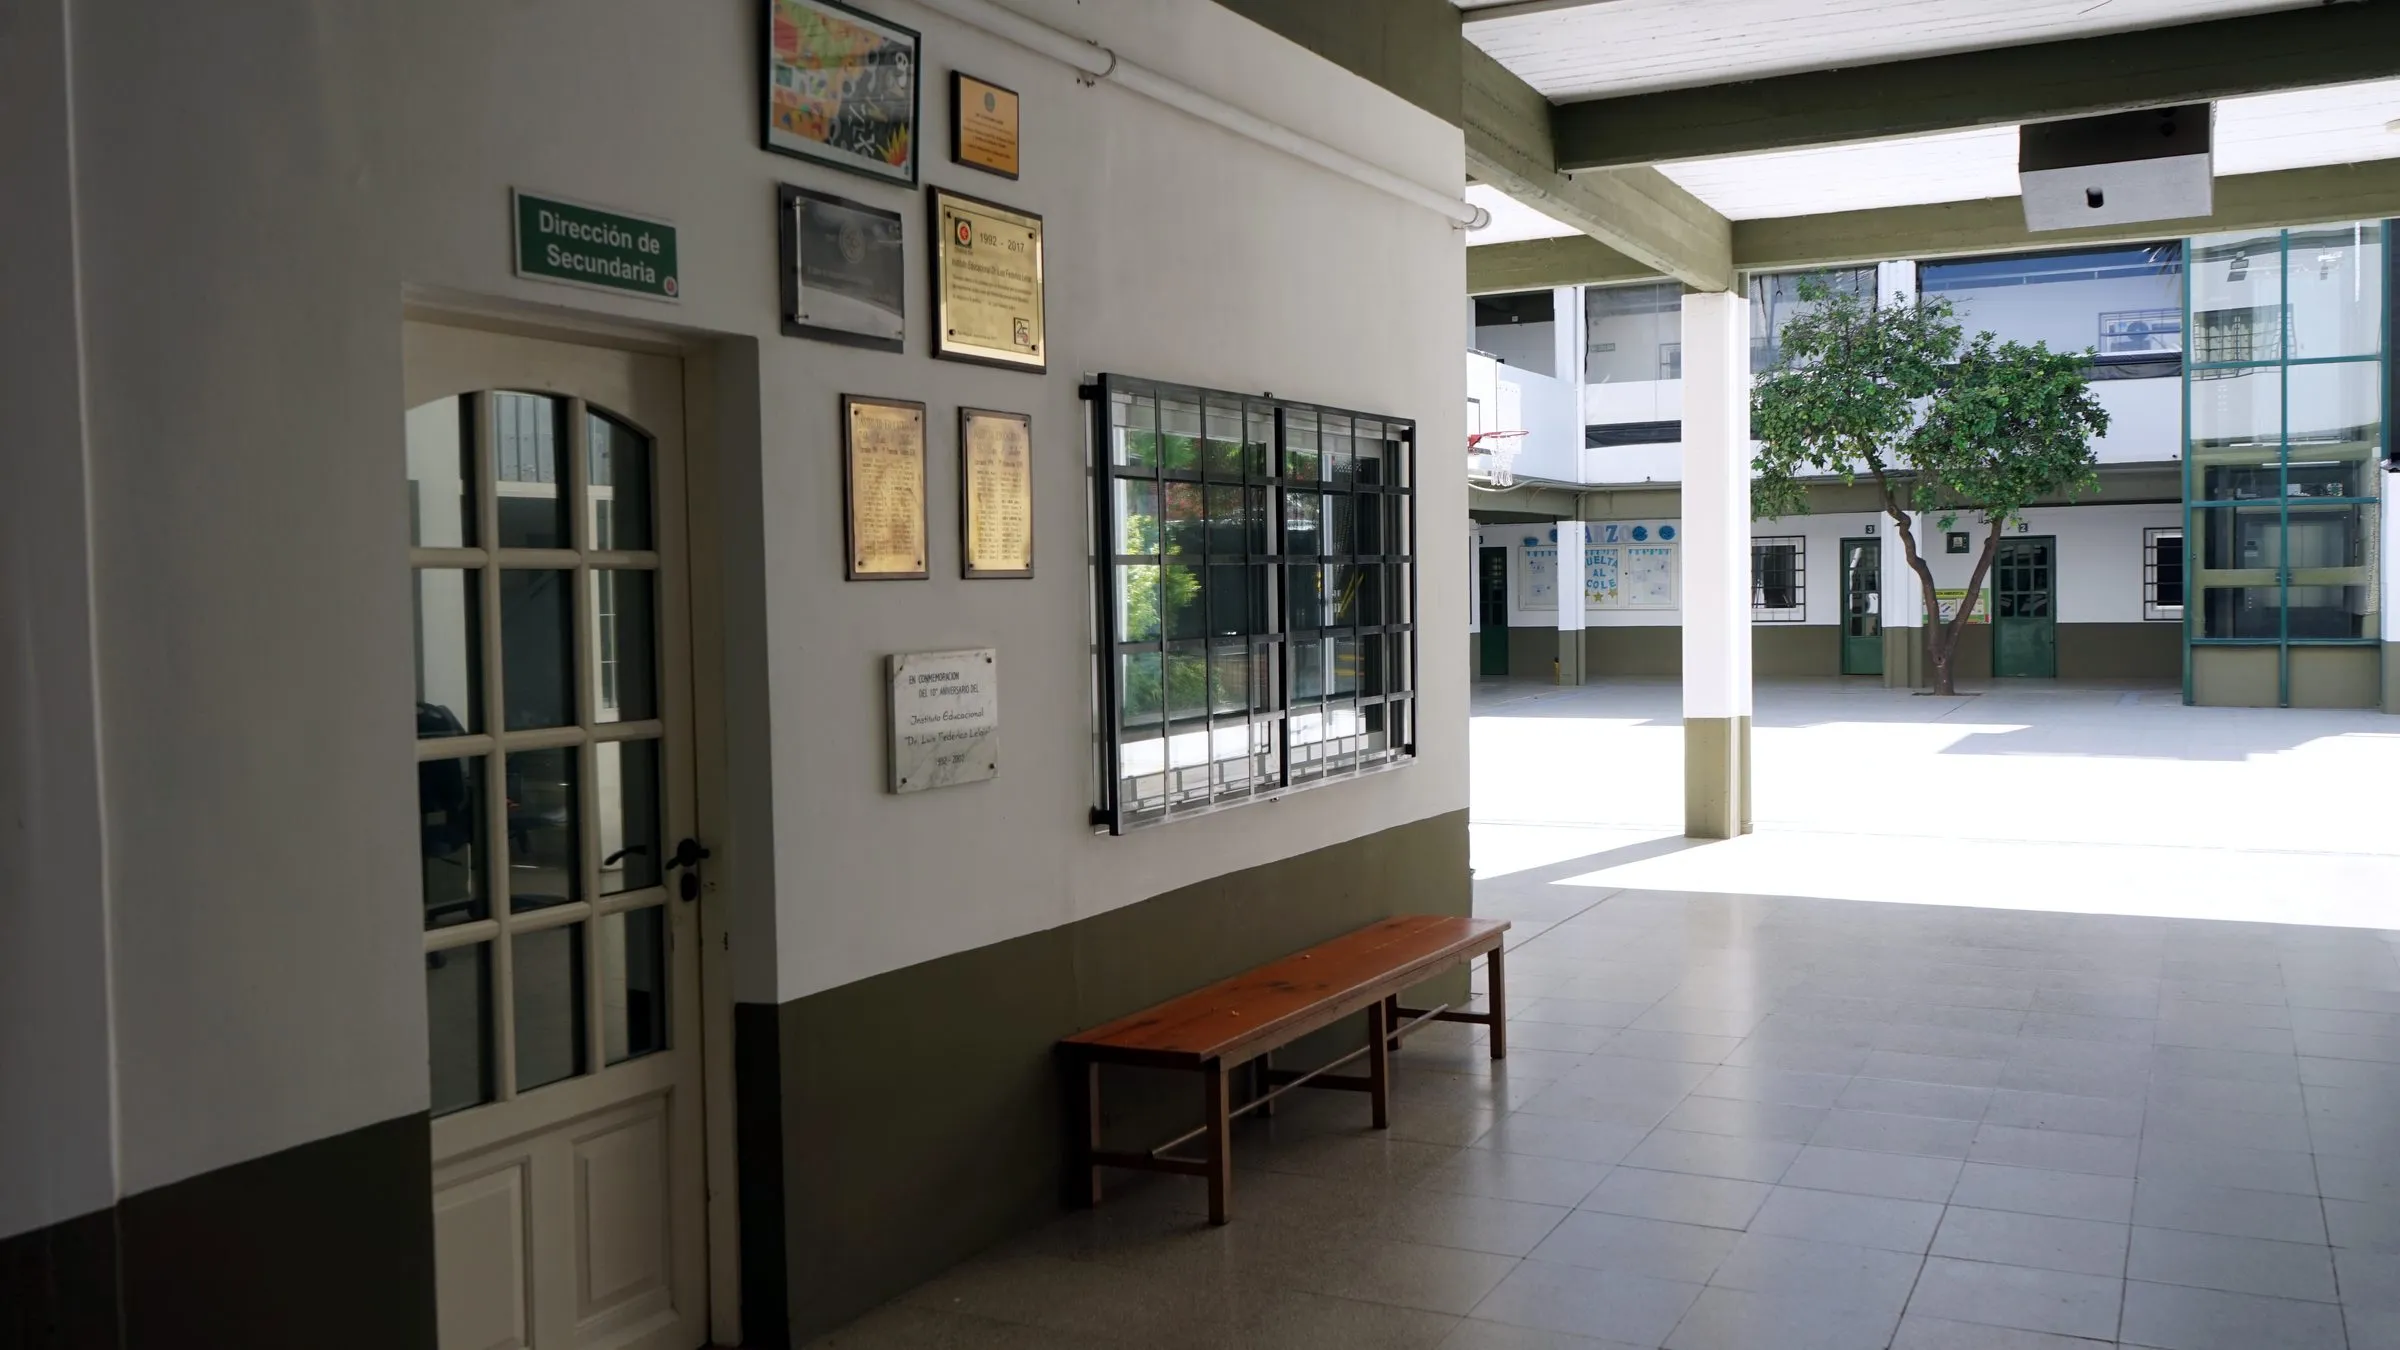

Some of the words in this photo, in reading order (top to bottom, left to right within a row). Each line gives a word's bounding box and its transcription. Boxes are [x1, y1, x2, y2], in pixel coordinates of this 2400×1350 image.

[539, 210, 632, 249] Dirección
[638, 232, 660, 255] de
[979, 232, 998, 247] 1992
[1007, 239, 1025, 253] 2017
[547, 243, 656, 284] Secundaria
[1585, 525, 1632, 542] ARZO
[1867, 524, 1873, 534] 3
[2020, 523, 2027, 532] 2
[1585, 556, 1618, 568] UELTA
[1593, 568, 1606, 577] AL
[1586, 579, 1616, 589] COLE
[919, 688, 928, 698] DEL
[970, 683, 979, 693] DEL
[942, 707, 984, 721] Educacional
